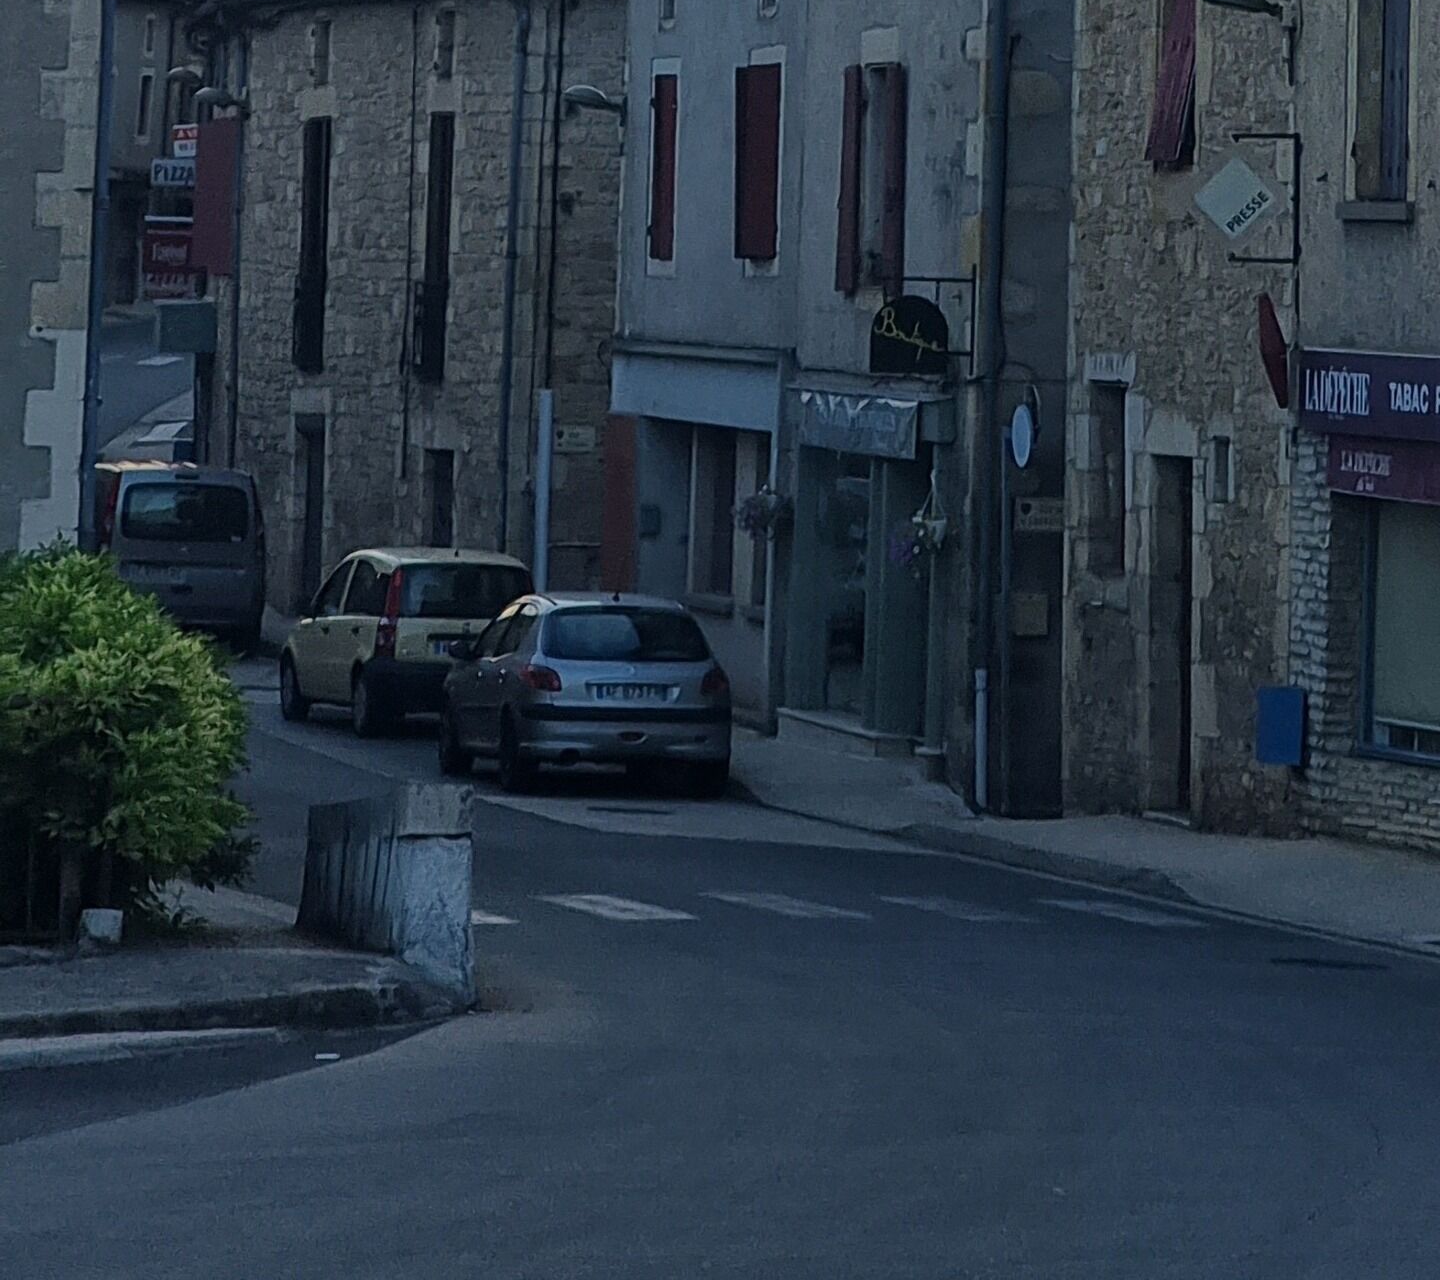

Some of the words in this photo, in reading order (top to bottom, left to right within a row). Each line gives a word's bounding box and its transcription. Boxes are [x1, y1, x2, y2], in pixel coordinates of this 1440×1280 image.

[154, 164, 195, 183] PIZZA
[1226, 191, 1269, 232] PRESSE
[1389, 382, 1429, 414] TABAC
